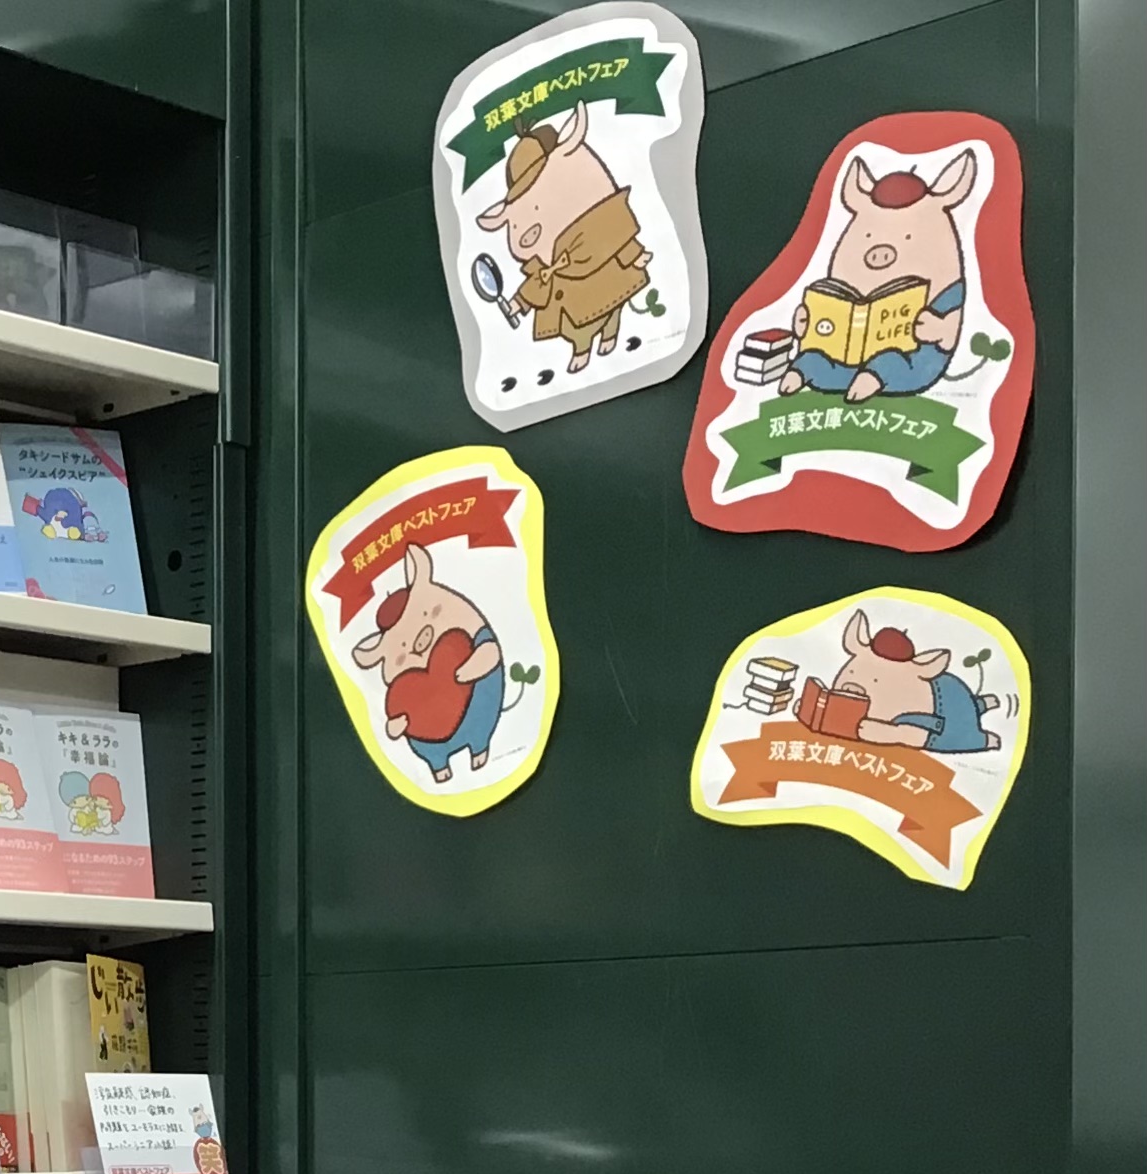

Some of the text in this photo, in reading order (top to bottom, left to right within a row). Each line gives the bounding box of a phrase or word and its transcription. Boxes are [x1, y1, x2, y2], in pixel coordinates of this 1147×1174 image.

[483, 57, 630, 132] 双葉文庫ベストフェア
[875, 323, 913, 342] LIFE
[879, 306, 912, 324] PIG
[769, 406, 938, 441] 双葉文庫ベストフェア
[19, 449, 103, 466] タキシードサムの
[351, 496, 477, 573] 双葉文庫ベストフェア
[769, 740, 935, 795] 双葉文庫ベストフェア
